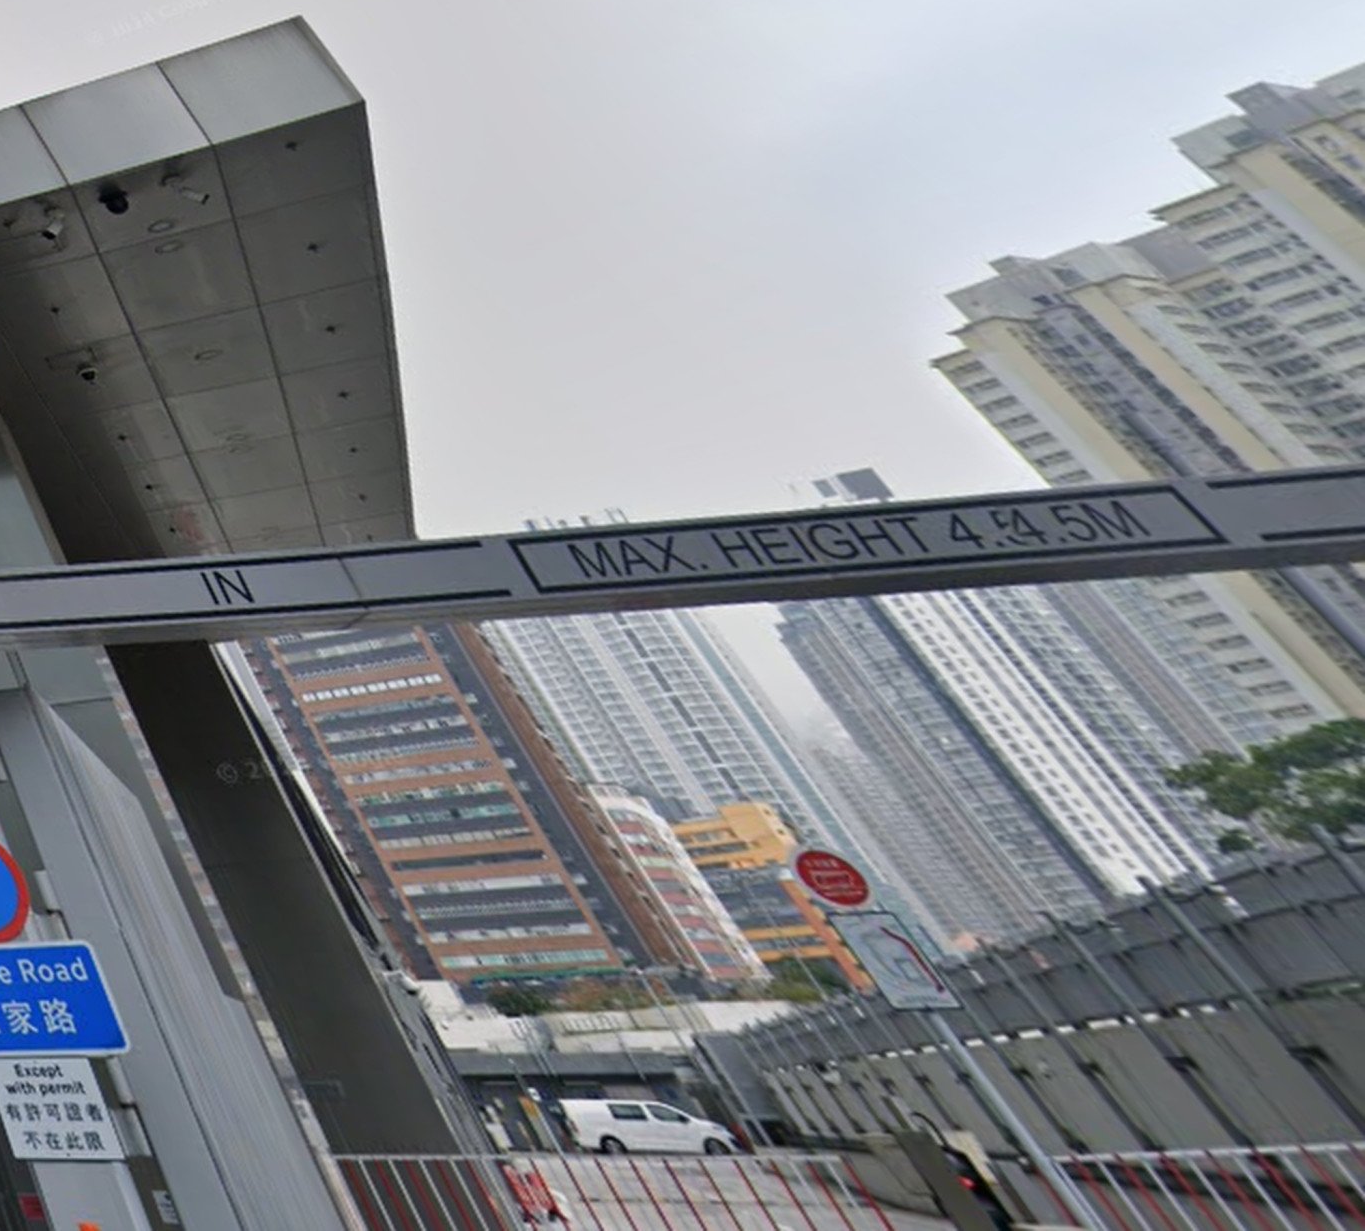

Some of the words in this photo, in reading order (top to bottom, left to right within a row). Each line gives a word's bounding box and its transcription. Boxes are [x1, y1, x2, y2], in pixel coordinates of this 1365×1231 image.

[569, 535, 708, 580] MAX.
[718, 516, 925, 568] HEIGHT
[200, 569, 255, 605] IN
[17, 957, 88, 983] Road
[13, 1063, 64, 1079] Except
[5, 1081, 37, 1095] with
[39, 1081, 86, 1097] permit
[23, 1131, 106, 1150] 不在此限
